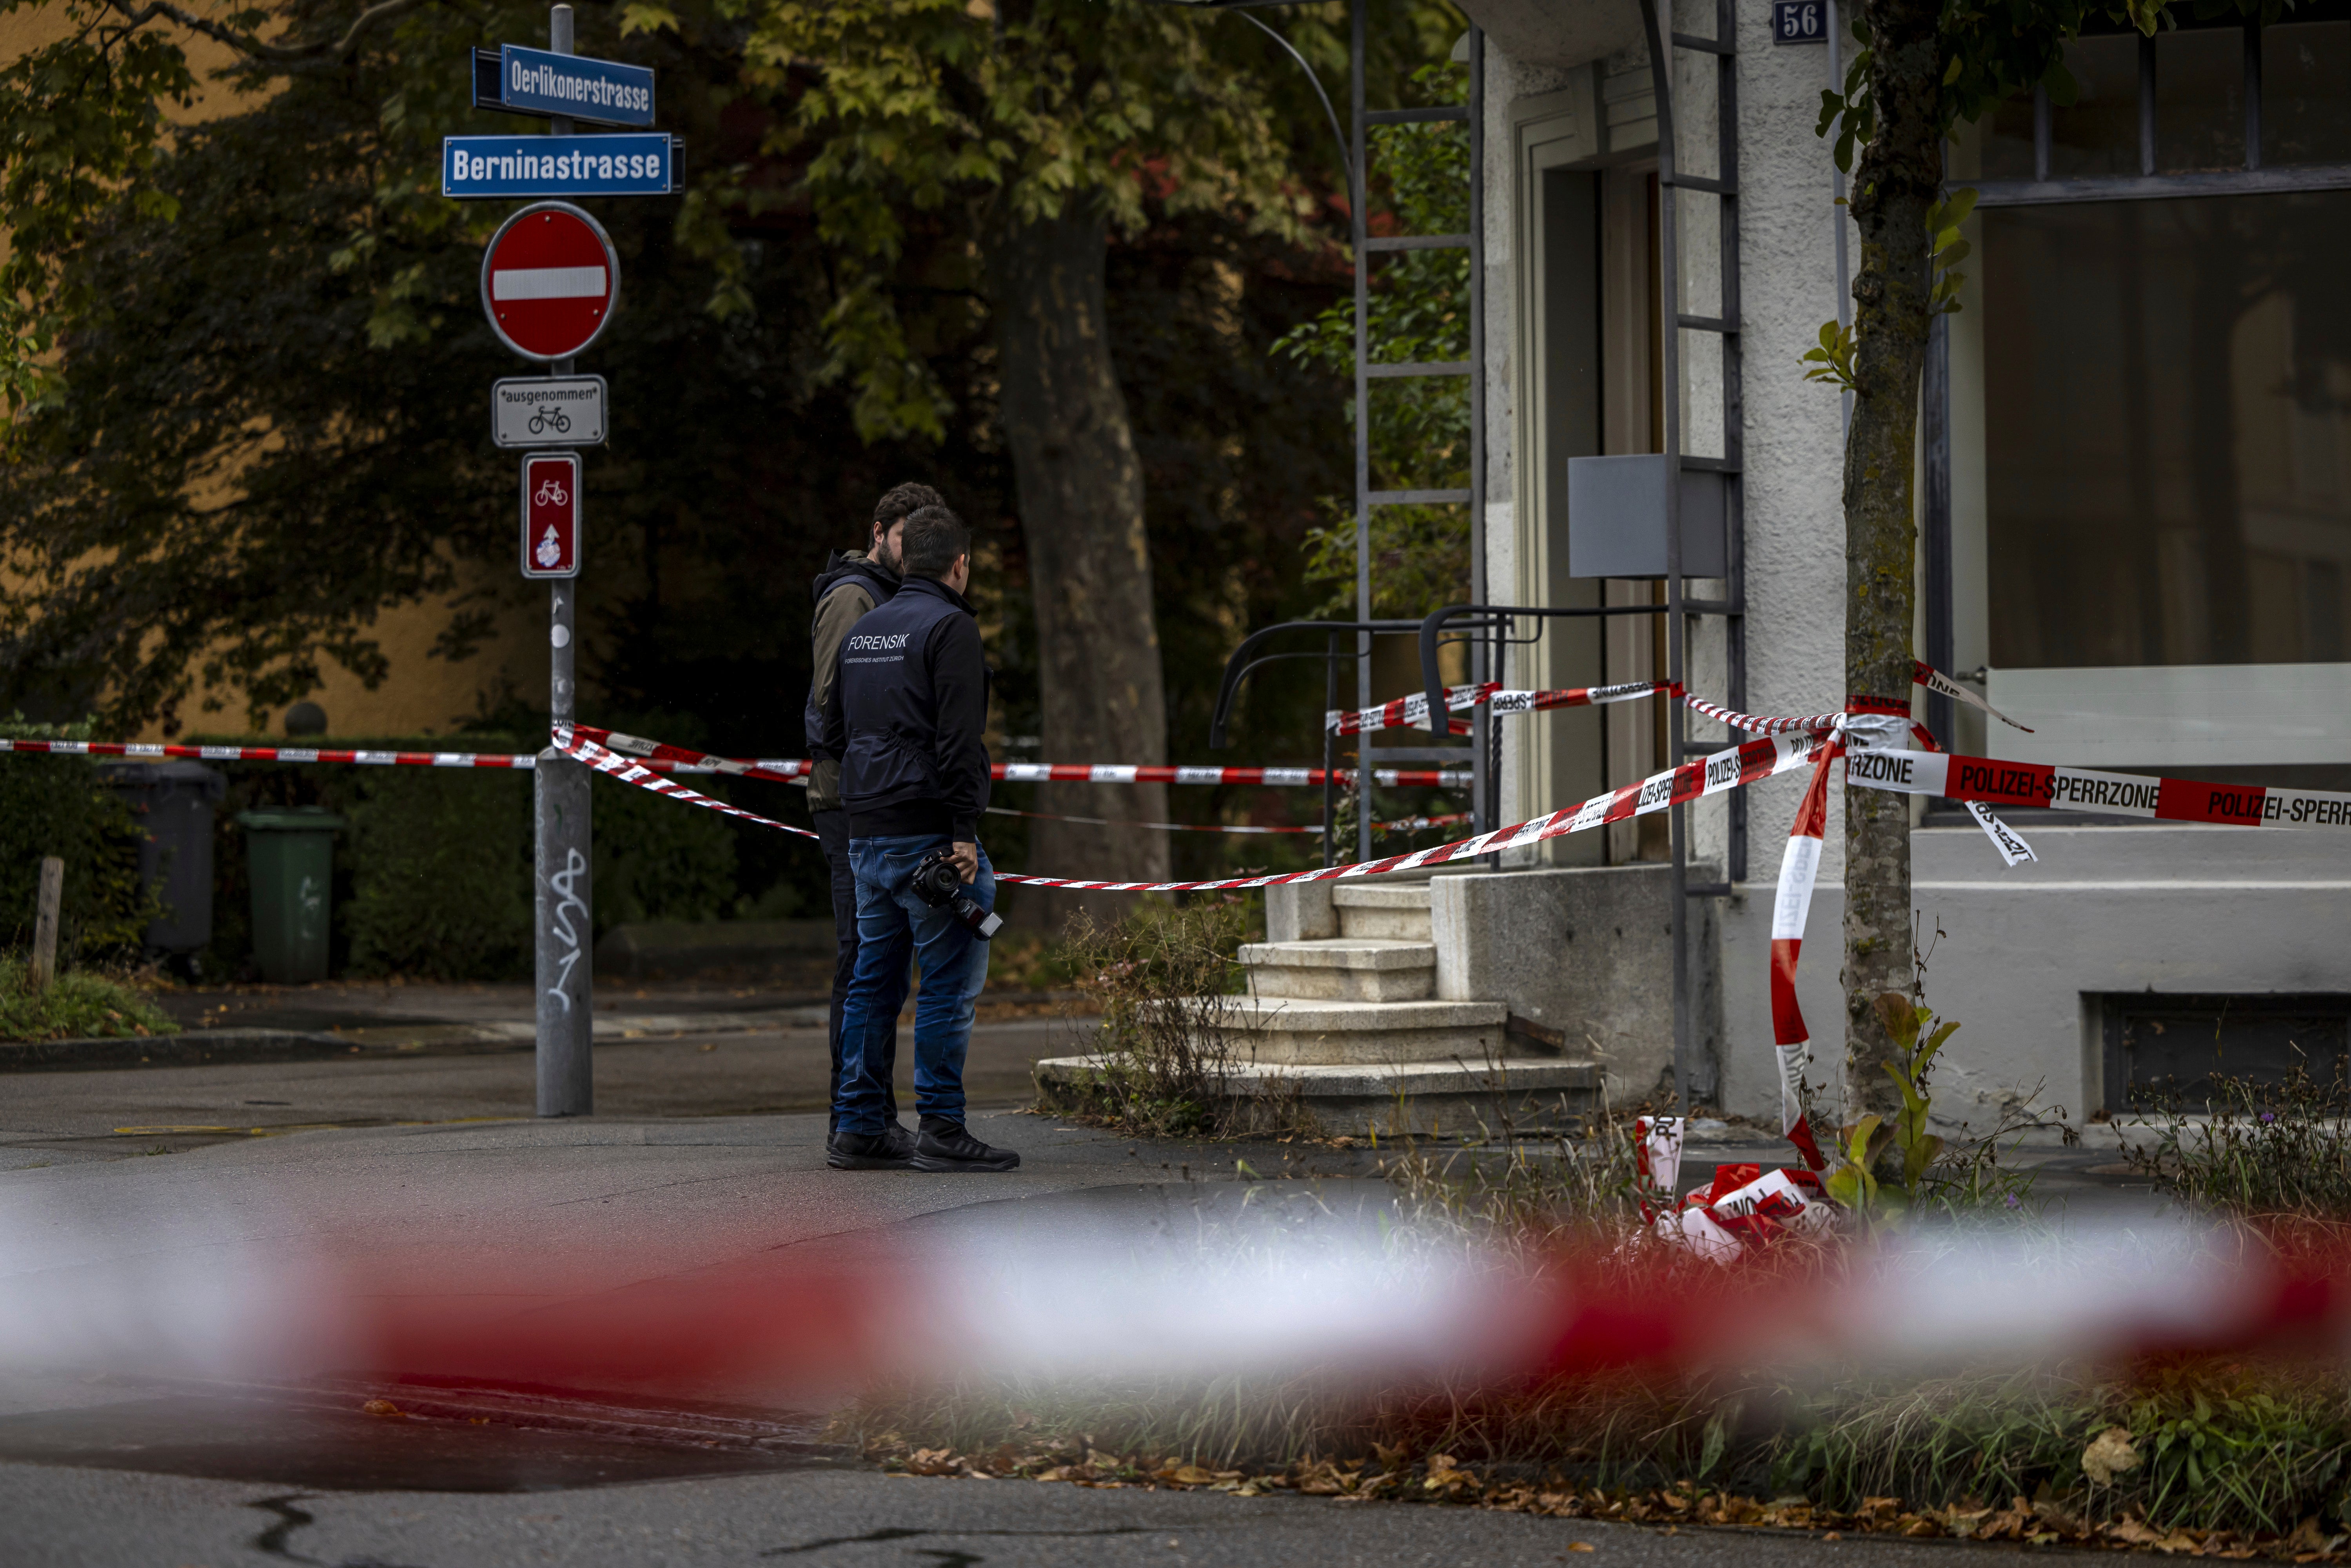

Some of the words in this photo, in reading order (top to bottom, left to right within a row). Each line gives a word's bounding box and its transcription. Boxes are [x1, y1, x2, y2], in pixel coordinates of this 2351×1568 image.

[1784, 5, 1817, 36] 56
[512, 60, 649, 111] Oerlikonerstrasse
[454, 149, 660, 181] Berninastrasse
[506, 389, 592, 405] ausgenommen
[848, 633, 910, 651] FORENSIK
[1961, 765, 2161, 809] POLIZEI-SPERRZONE
[951, 888, 960, 898] Nikon
